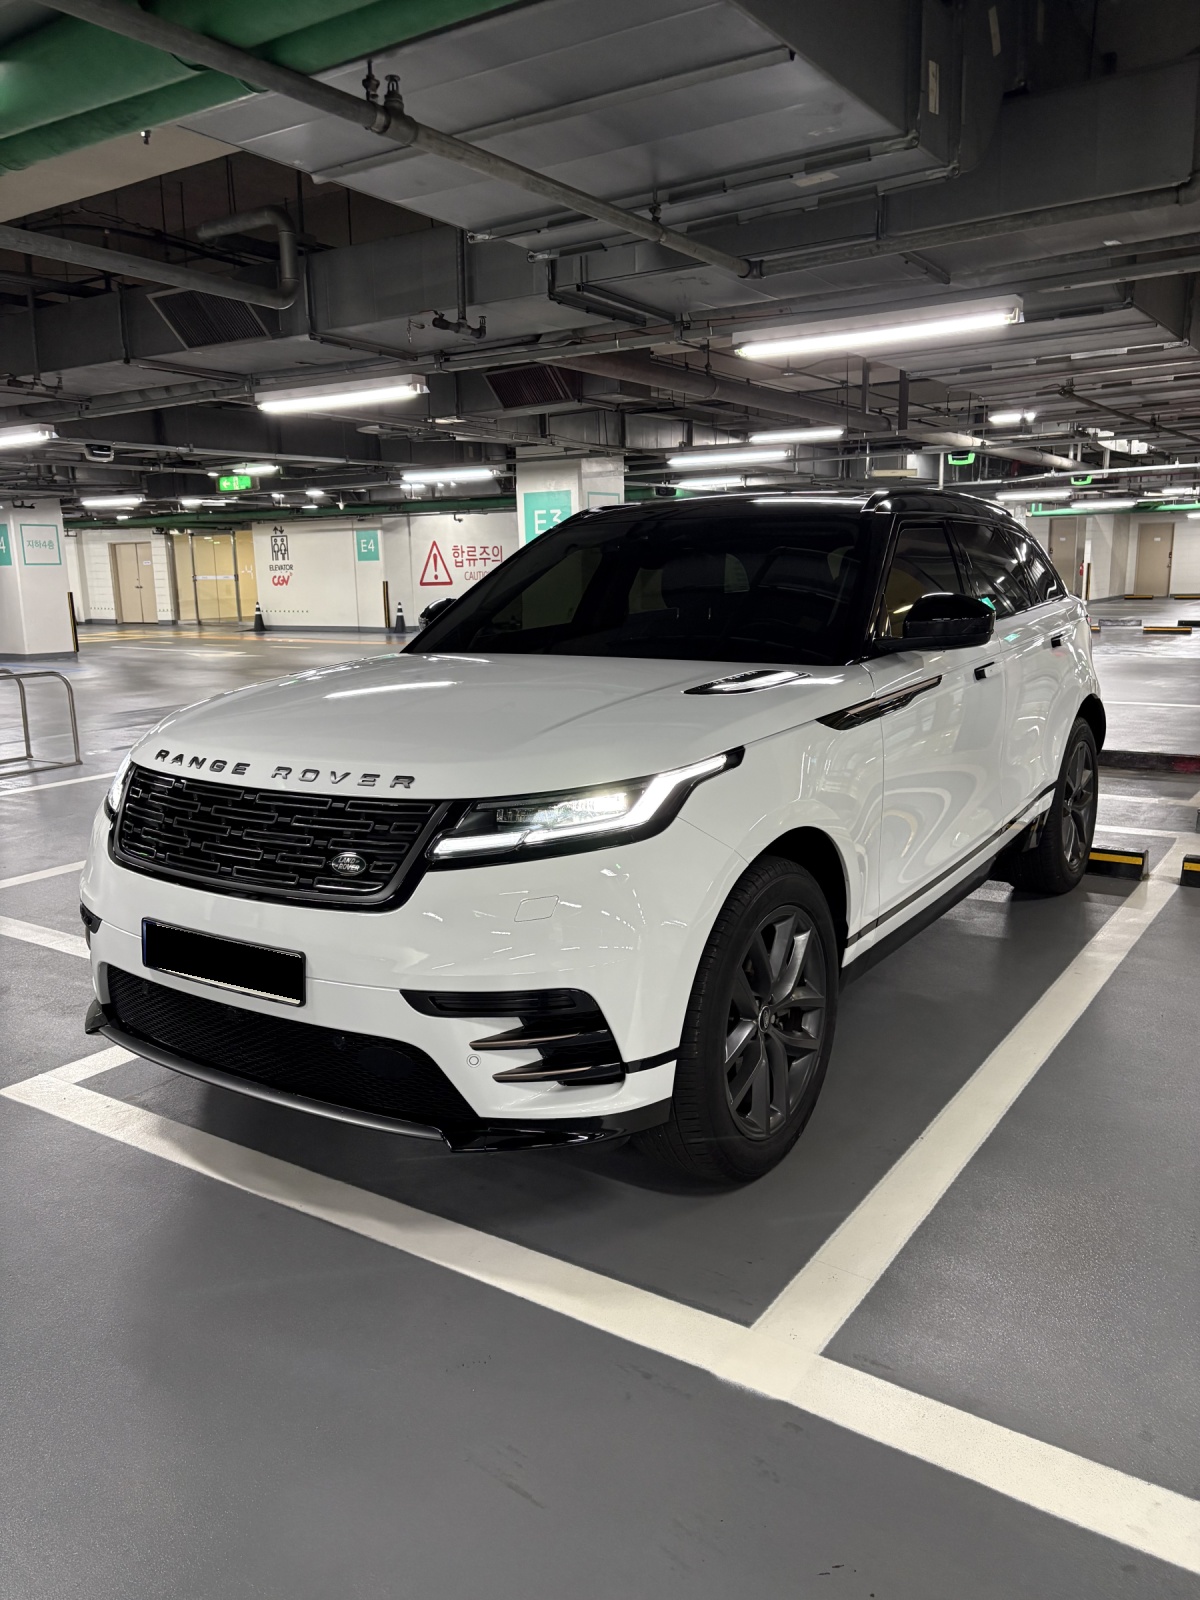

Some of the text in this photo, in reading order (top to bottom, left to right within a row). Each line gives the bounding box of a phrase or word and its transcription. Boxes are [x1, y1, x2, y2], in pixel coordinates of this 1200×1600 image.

[533, 508, 562, 535] E3
[27, 539, 55, 550] 지하4층
[360, 538, 375, 553] E4
[451, 544, 503, 568] 합류주의
[271, 575, 290, 587] CGV
[154, 748, 416, 789] RANGE ROVER
[337, 863, 361, 871] ROVER
